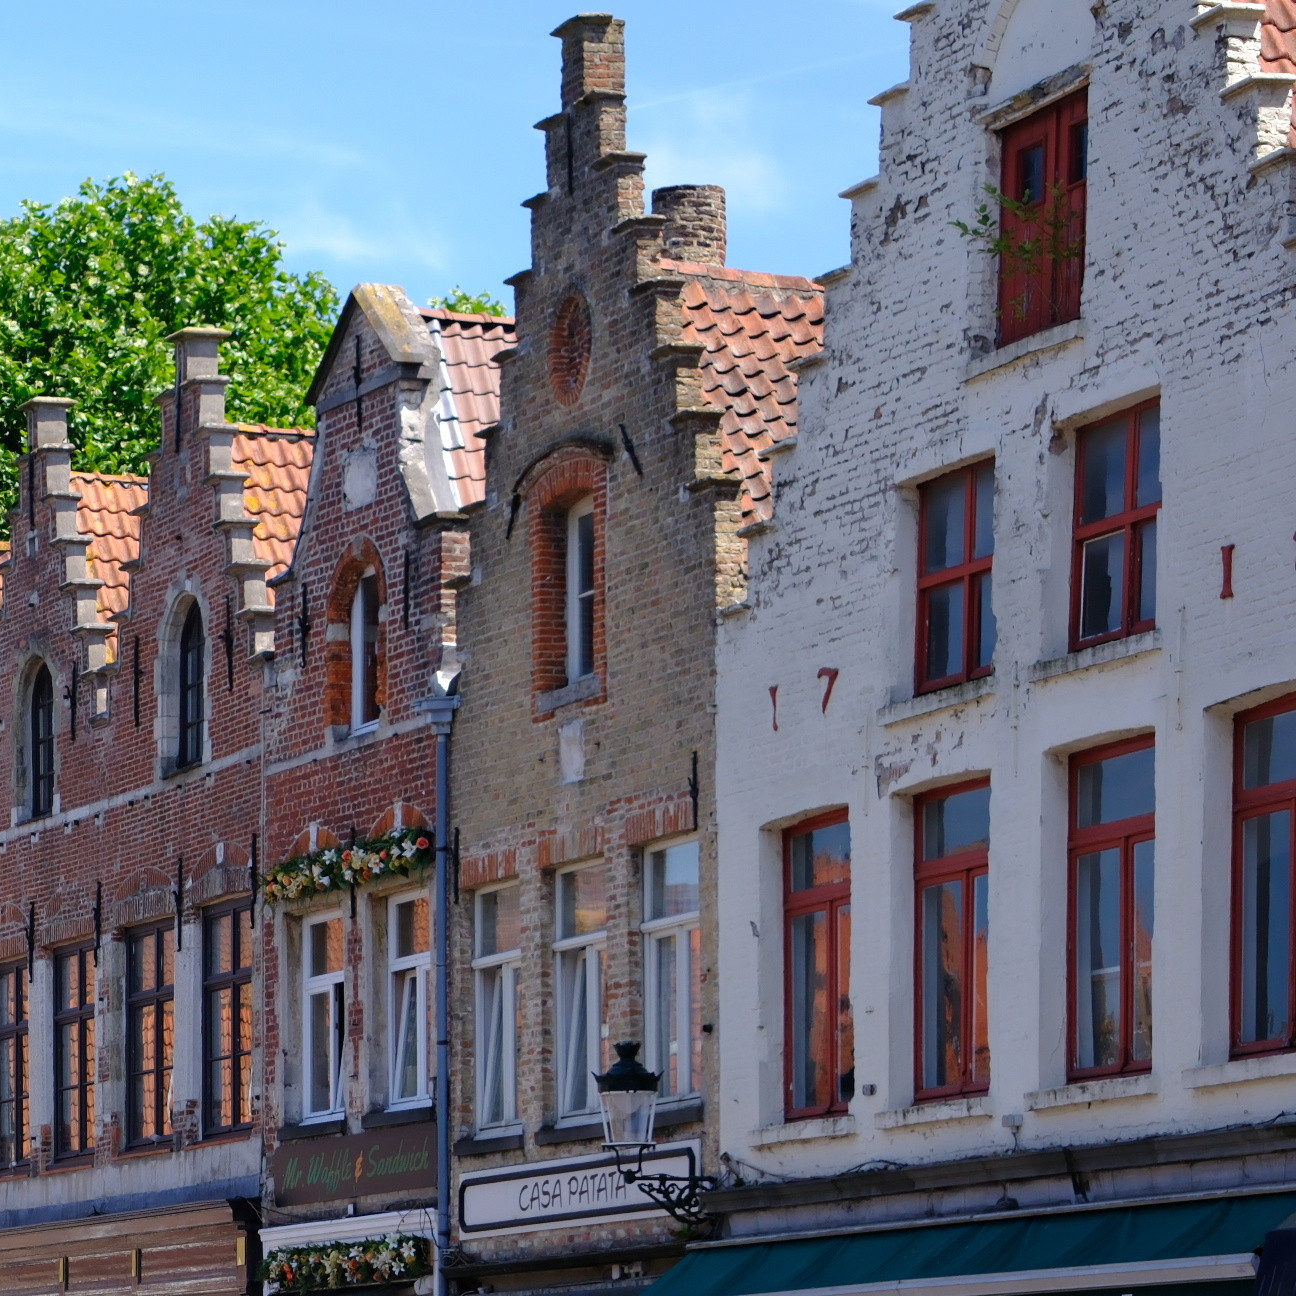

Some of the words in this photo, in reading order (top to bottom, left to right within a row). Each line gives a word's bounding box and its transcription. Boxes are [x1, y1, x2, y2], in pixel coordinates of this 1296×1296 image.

[306, 1149, 353, 1193] Waffle
[366, 1135, 430, 1178] Sandwich
[518, 1179, 563, 1212] CASA
[567, 1170, 628, 1204] PATATA
